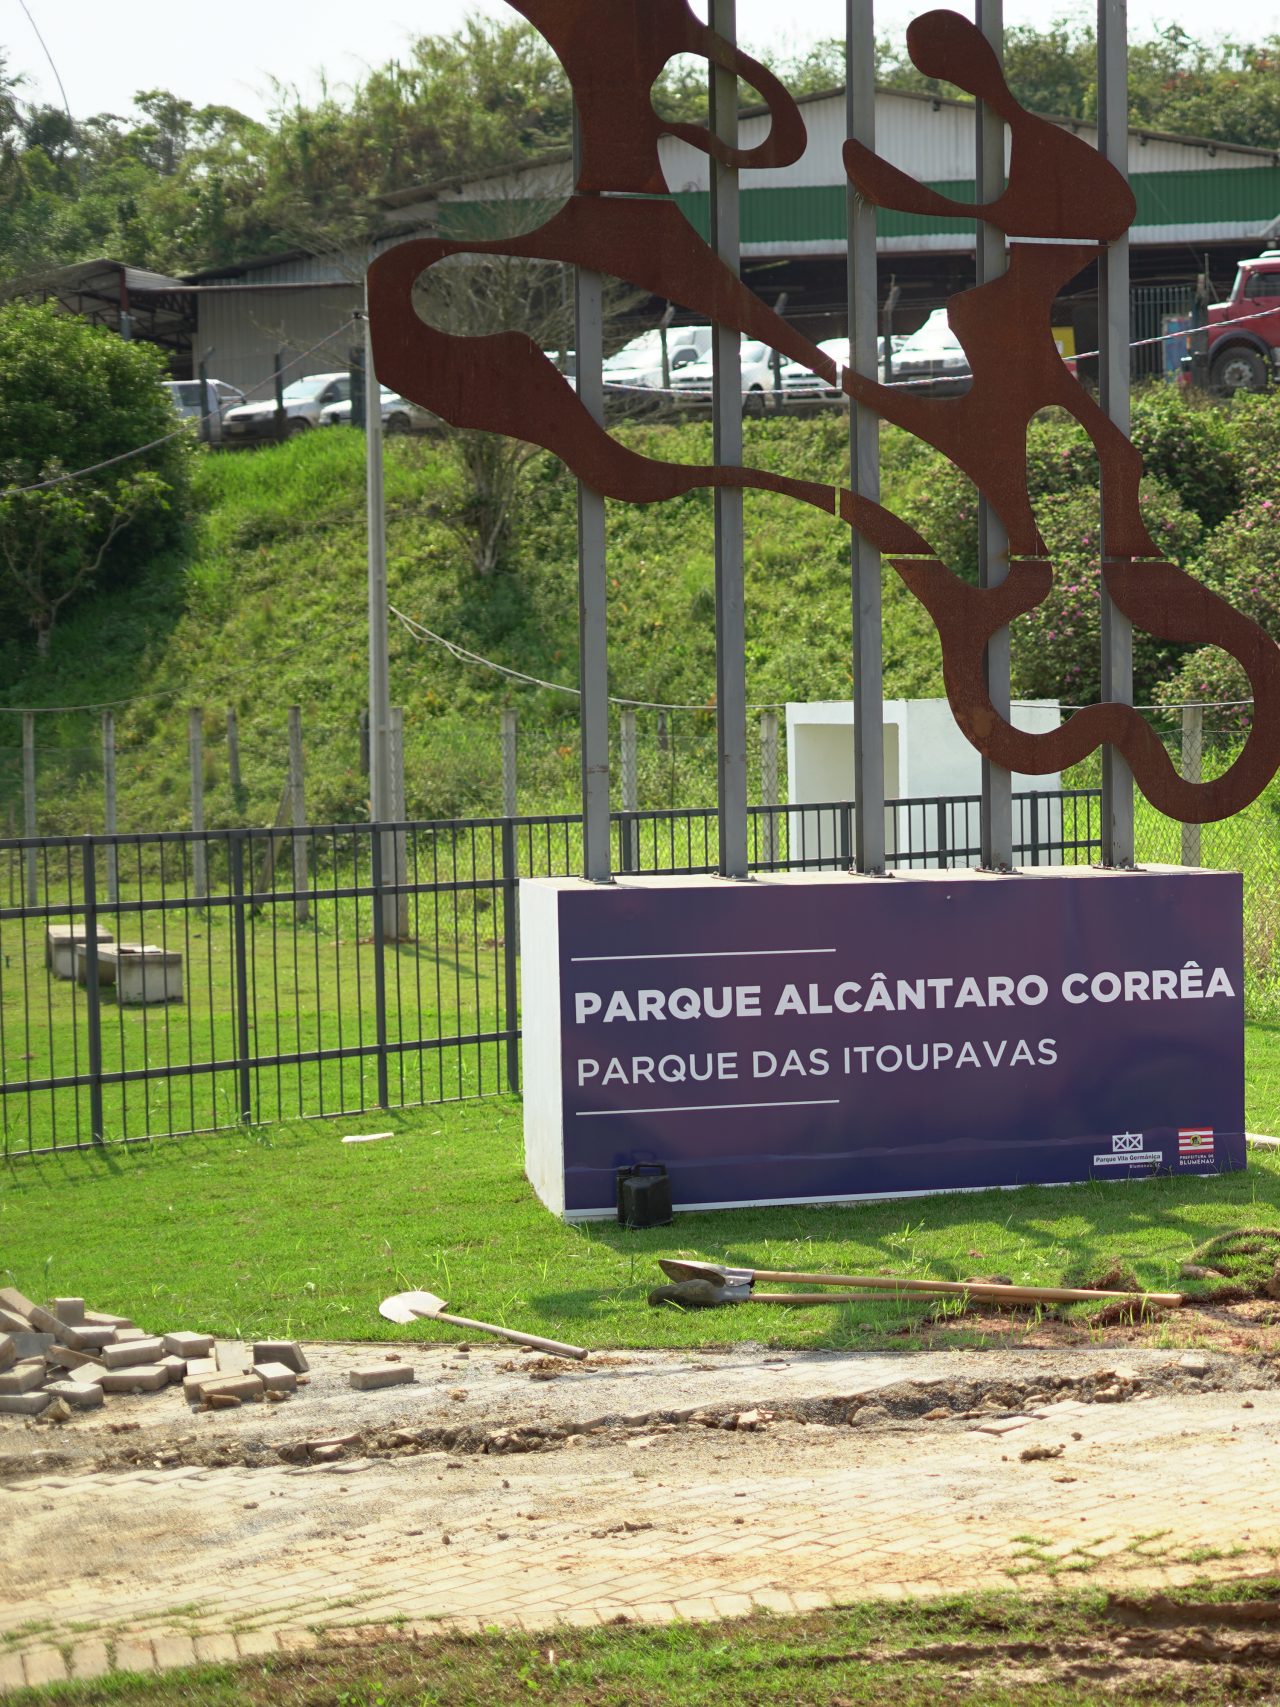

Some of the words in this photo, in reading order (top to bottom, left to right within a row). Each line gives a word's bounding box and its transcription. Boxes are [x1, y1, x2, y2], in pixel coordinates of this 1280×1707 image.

[575, 985, 762, 1024] PARQUE
[774, 972, 1049, 1016] ALCÂNTARO
[1061, 961, 1236, 1004] CORRÊA
[577, 1051, 739, 1086] PARQUE
[753, 1048, 830, 1078] DAS
[843, 1038, 1058, 1075] ITOUPAVAS
[1096, 1156, 1116, 1164] Parque
